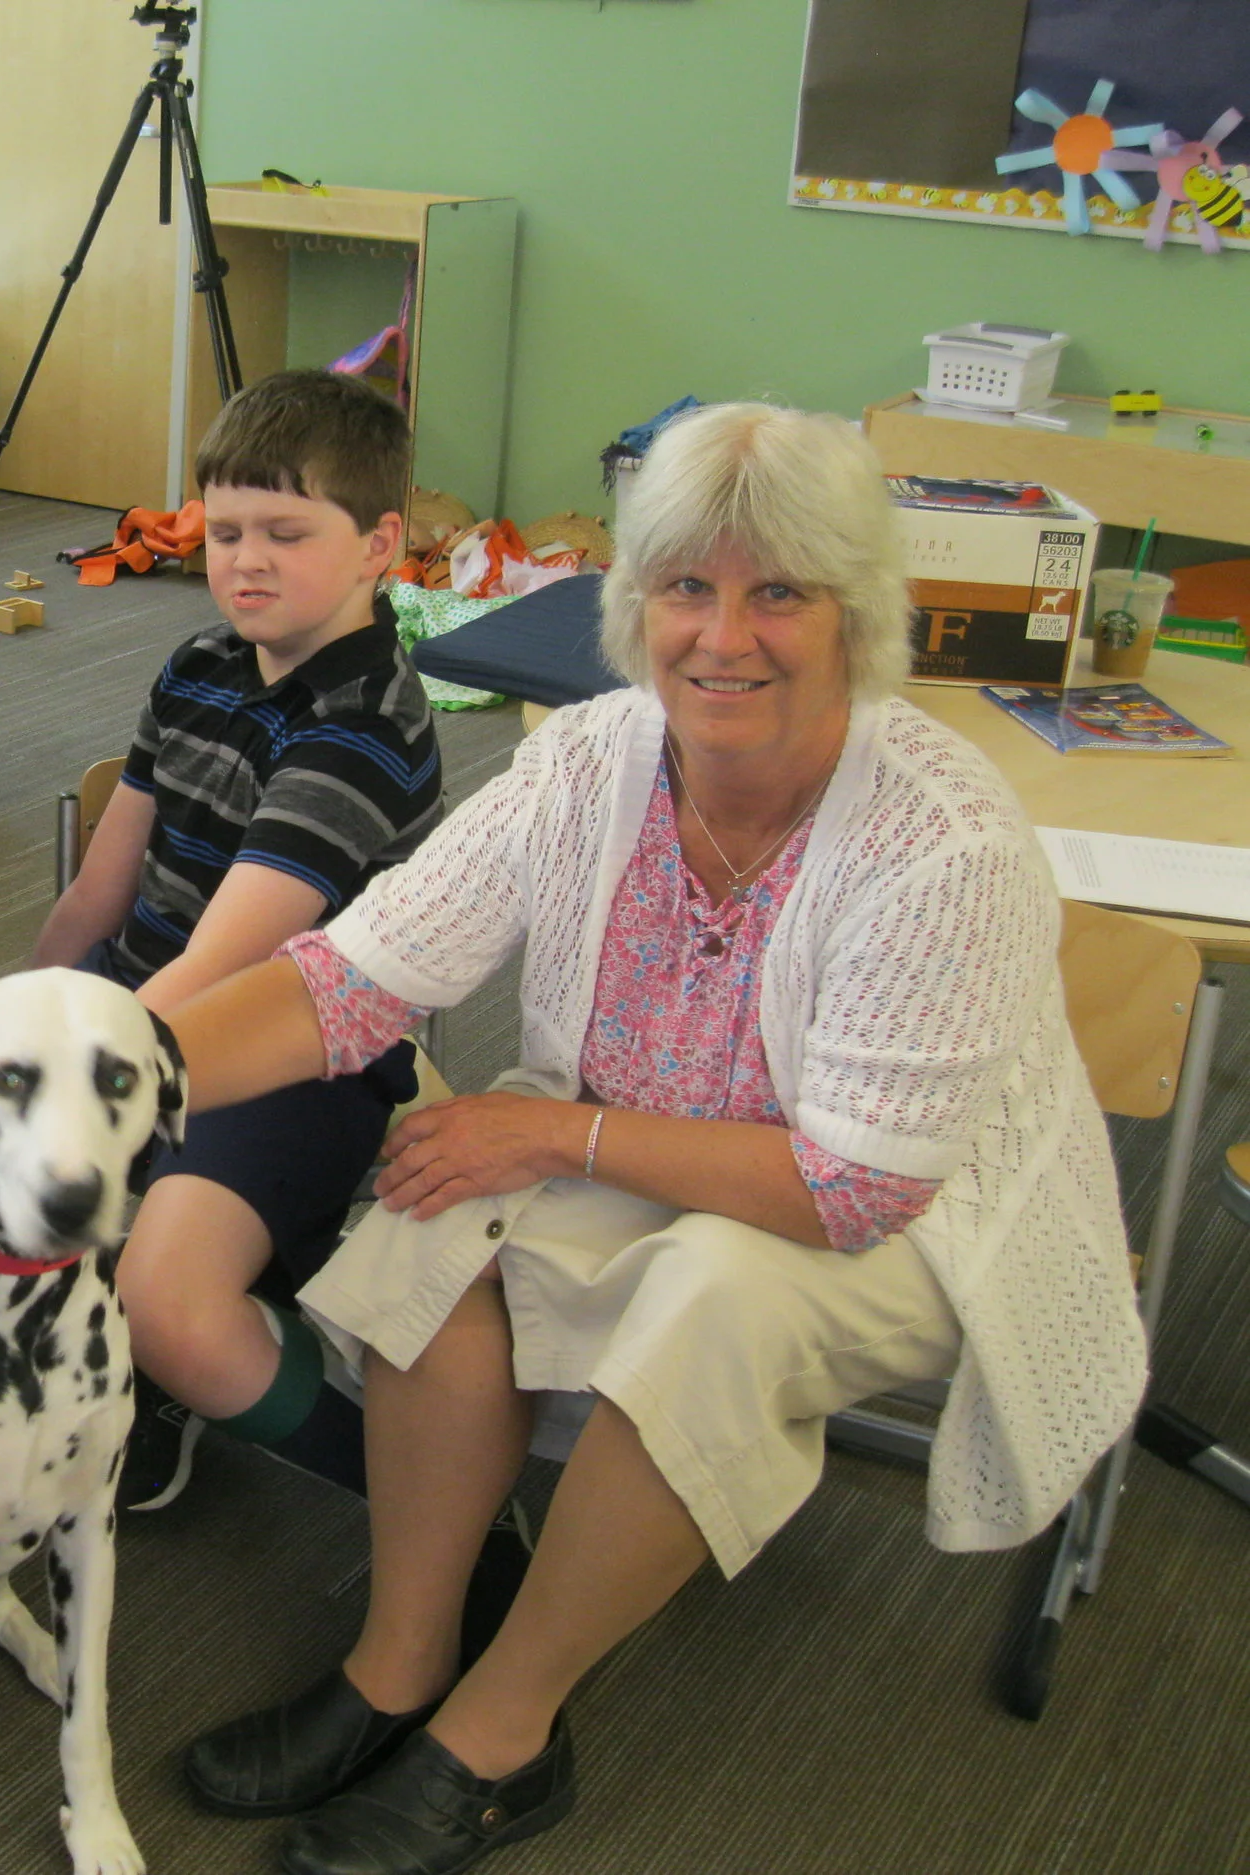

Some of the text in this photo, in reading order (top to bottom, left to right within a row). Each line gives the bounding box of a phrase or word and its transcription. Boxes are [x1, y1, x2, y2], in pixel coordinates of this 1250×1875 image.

[1043, 533, 1080, 544] 38100
[1042, 545, 1078, 556] 56203
[1042, 579, 1069, 587] CANS
[925, 609, 973, 653] F
